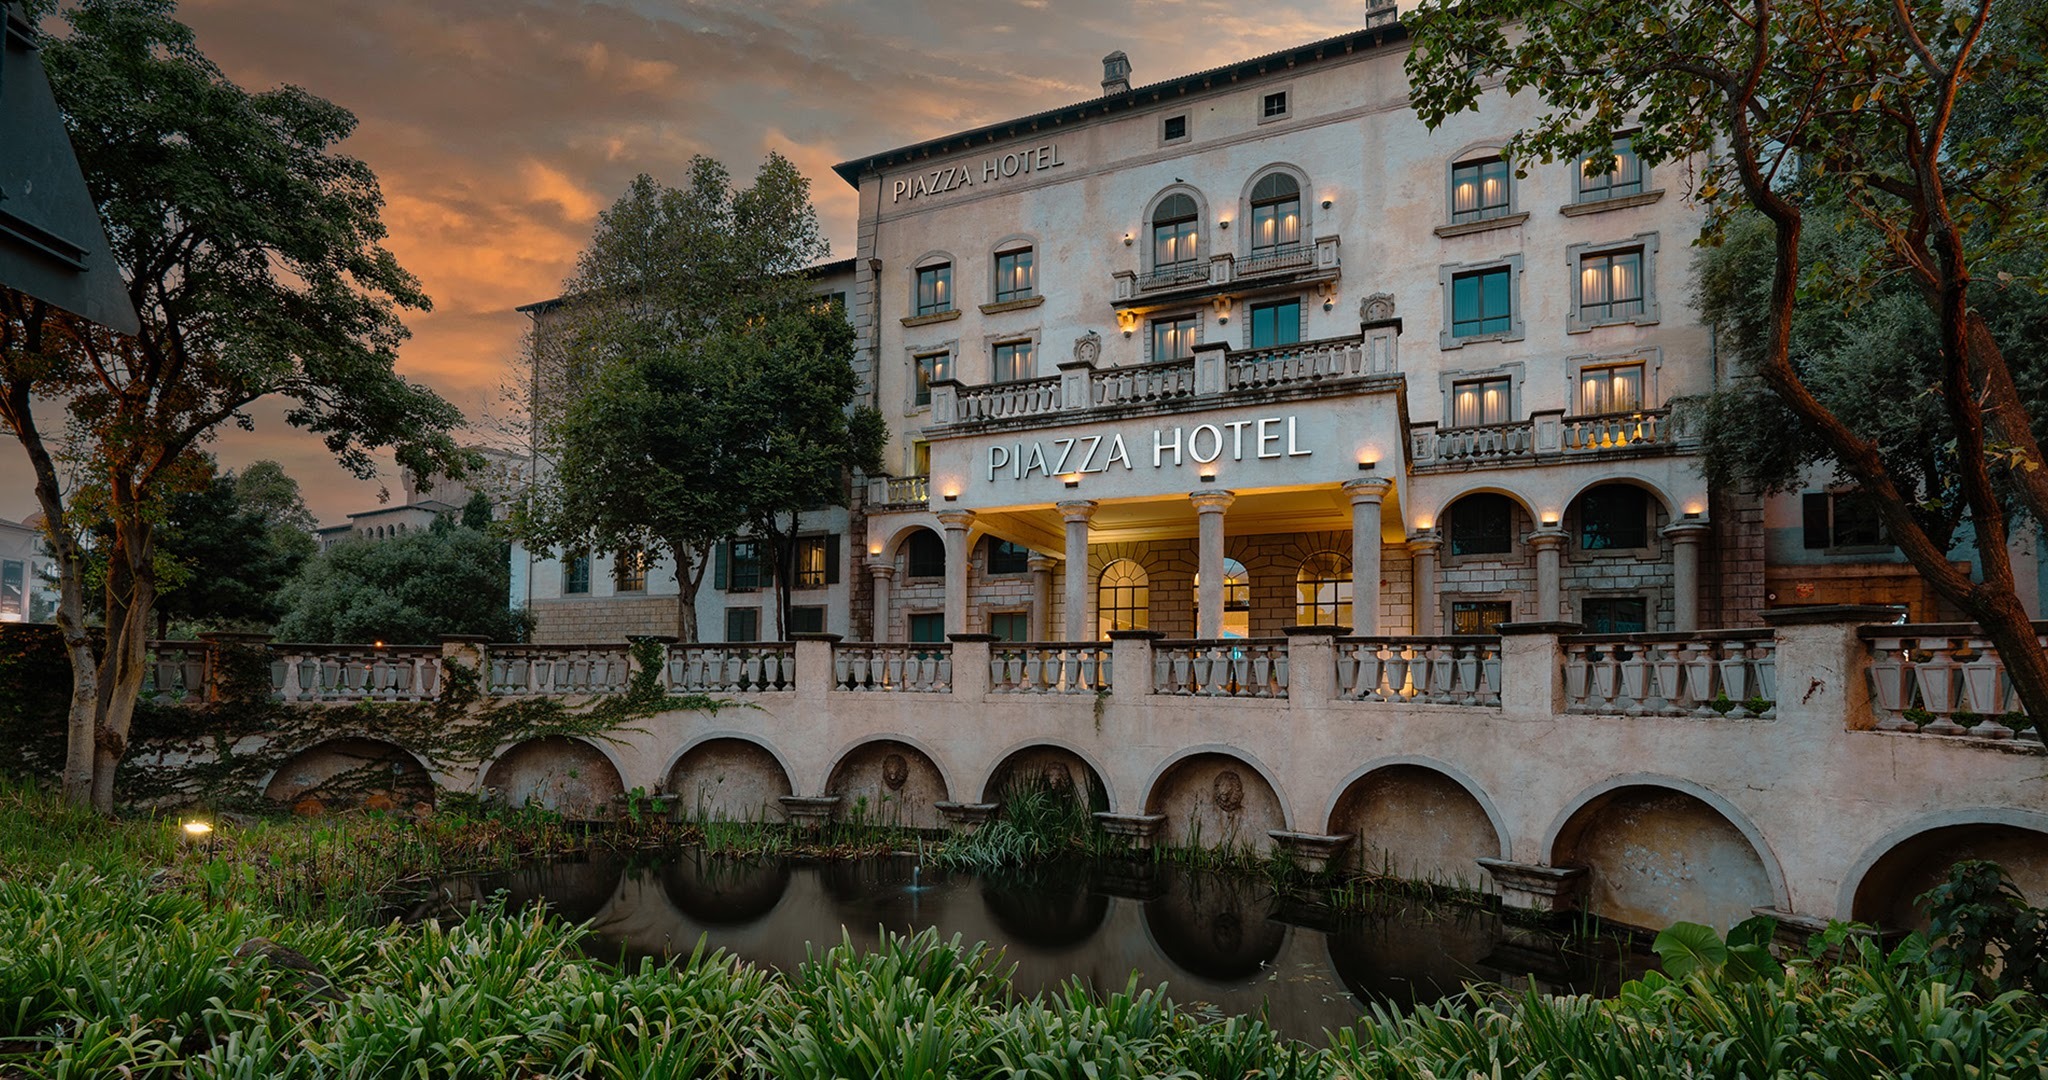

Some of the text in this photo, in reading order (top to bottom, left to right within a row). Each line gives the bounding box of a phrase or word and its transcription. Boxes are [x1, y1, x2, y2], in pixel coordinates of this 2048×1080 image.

[893, 144, 1065, 203] PIAZZA HOTEL
[987, 416, 1312, 482] PIAZZA HOTEL
